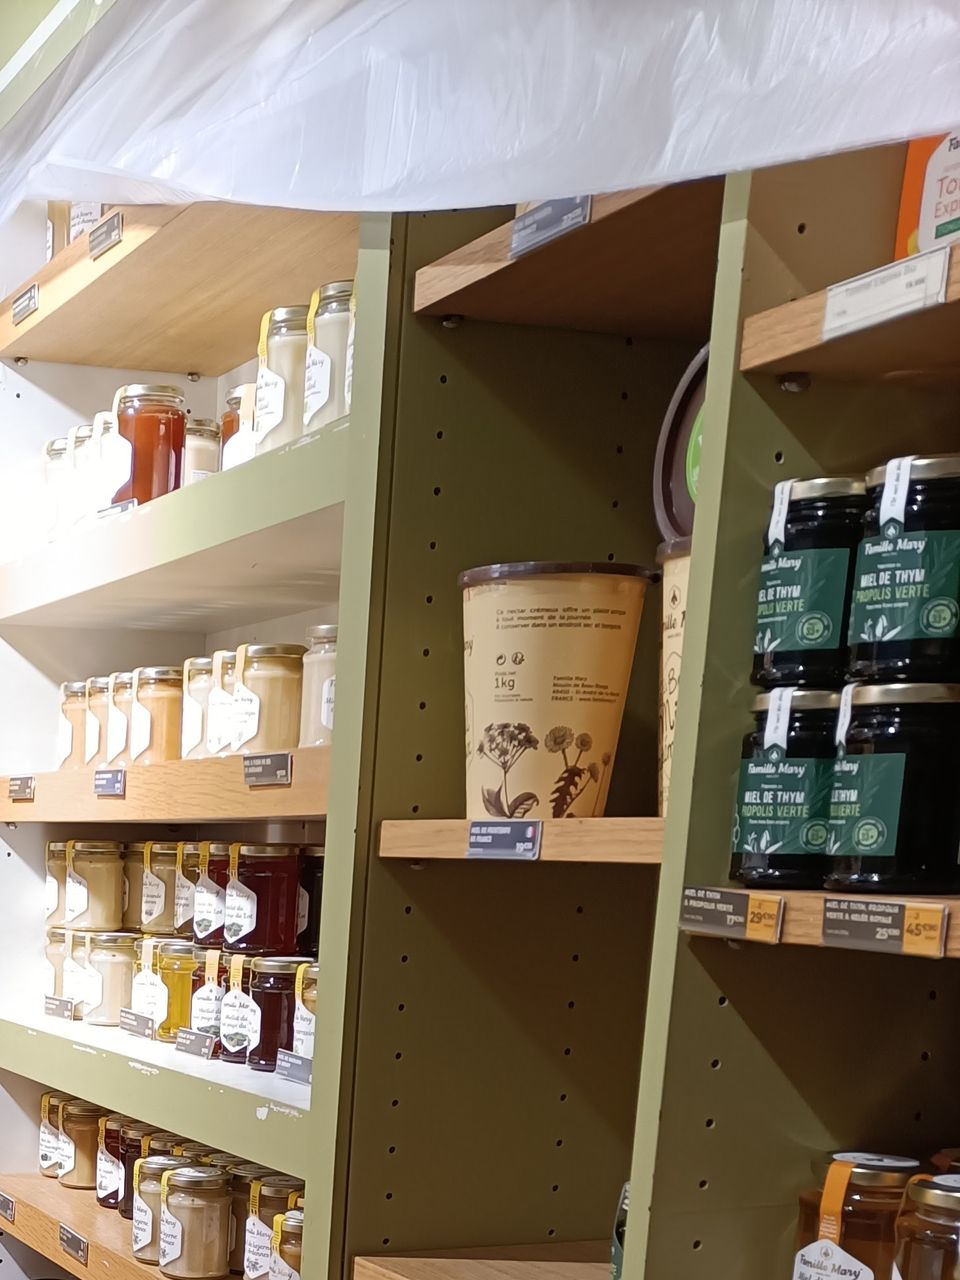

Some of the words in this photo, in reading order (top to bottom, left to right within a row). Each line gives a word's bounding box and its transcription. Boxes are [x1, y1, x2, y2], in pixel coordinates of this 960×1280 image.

[937, 176, 960, 198] TO
[865, 540, 894, 555] Famille
[896, 538, 925, 554] Mary
[778, 557, 801, 571] Mary
[860, 573, 877, 588] MIEL
[879, 571, 891, 585] DE
[895, 569, 925, 583] THYM
[776, 585, 801, 599] THYM
[895, 584, 929, 599] VERTE
[775, 599, 805, 613] VERTE
[494, 678, 516, 690] 1kg
[748, 762, 776, 774] Famille
[778, 762, 805, 778] Mary
[744, 791, 761, 803] MIEL
[763, 791, 774, 803] DE
[777, 791, 805, 803] THYM
[776, 805, 810, 818] VERTE
[800, 1254, 828, 1271] Famille
[831, 1263, 860, 1280] Mary
